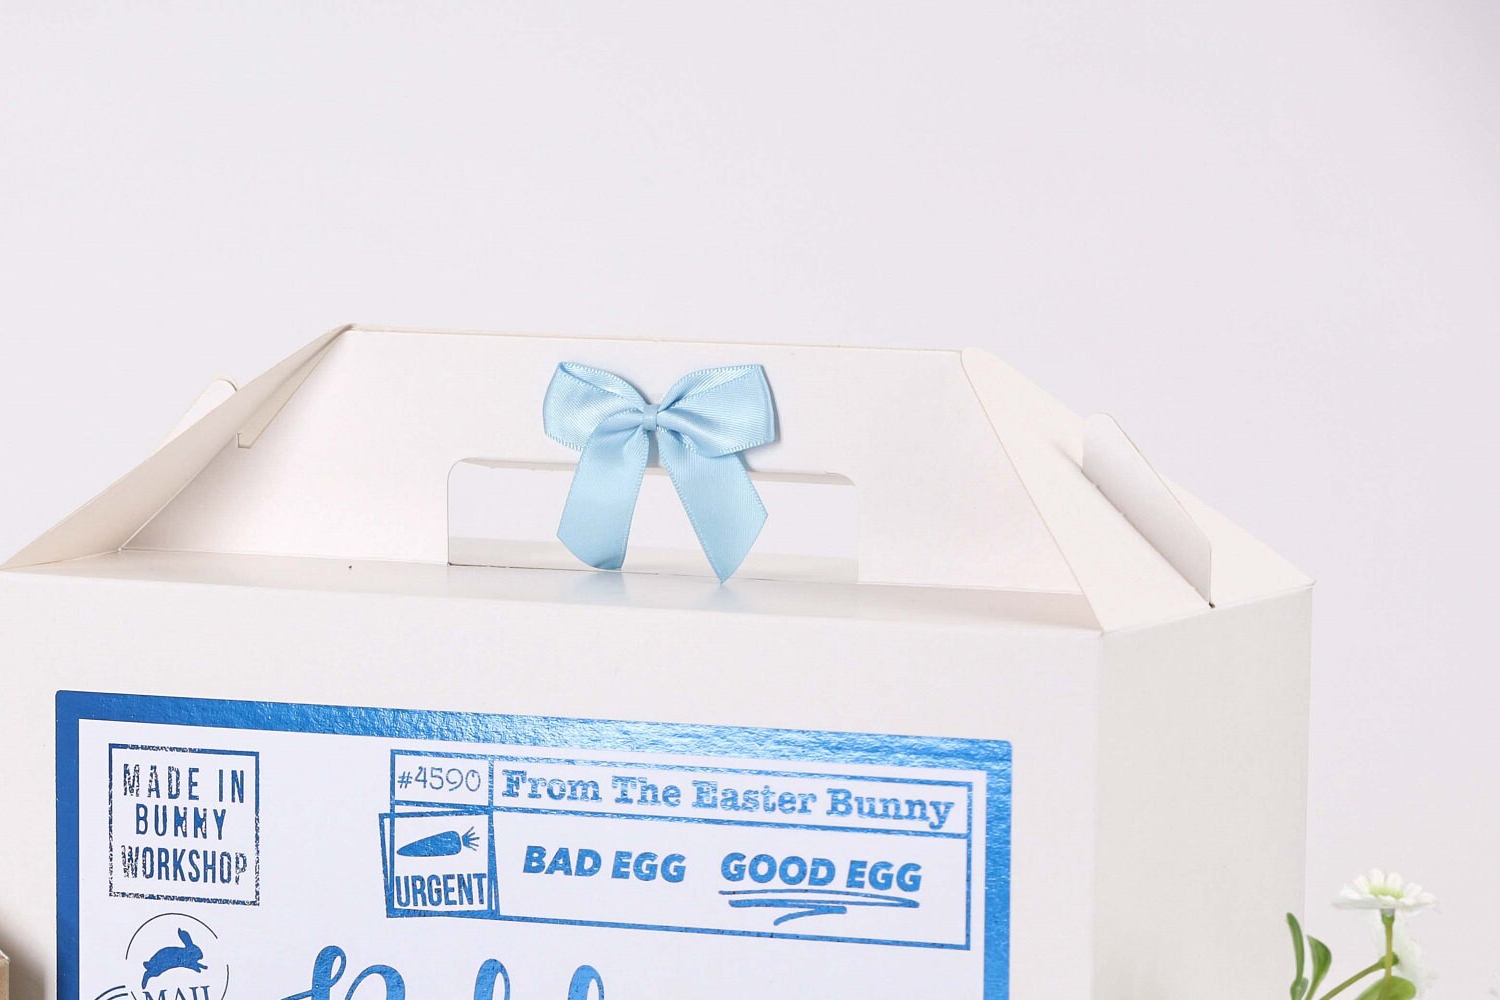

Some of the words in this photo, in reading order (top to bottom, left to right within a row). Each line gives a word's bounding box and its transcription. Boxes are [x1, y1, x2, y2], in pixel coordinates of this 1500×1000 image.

[123, 763, 200, 800] MADE
[218, 769, 245, 803] IN
[397, 764, 482, 793] #4590
[501, 769, 603, 803] From
[611, 775, 682, 809] The
[691, 779, 817, 815] Easter
[826, 786, 955, 830] Bunny
[136, 804, 227, 840] BUNNY
[120, 845, 248, 885] WORKSHOP
[522, 845, 603, 879] BAD
[611, 850, 687, 884] EGG
[720, 852, 837, 887] GOOD
[846, 857, 922, 892] EGG
[395, 872, 487, 907] URGENT
